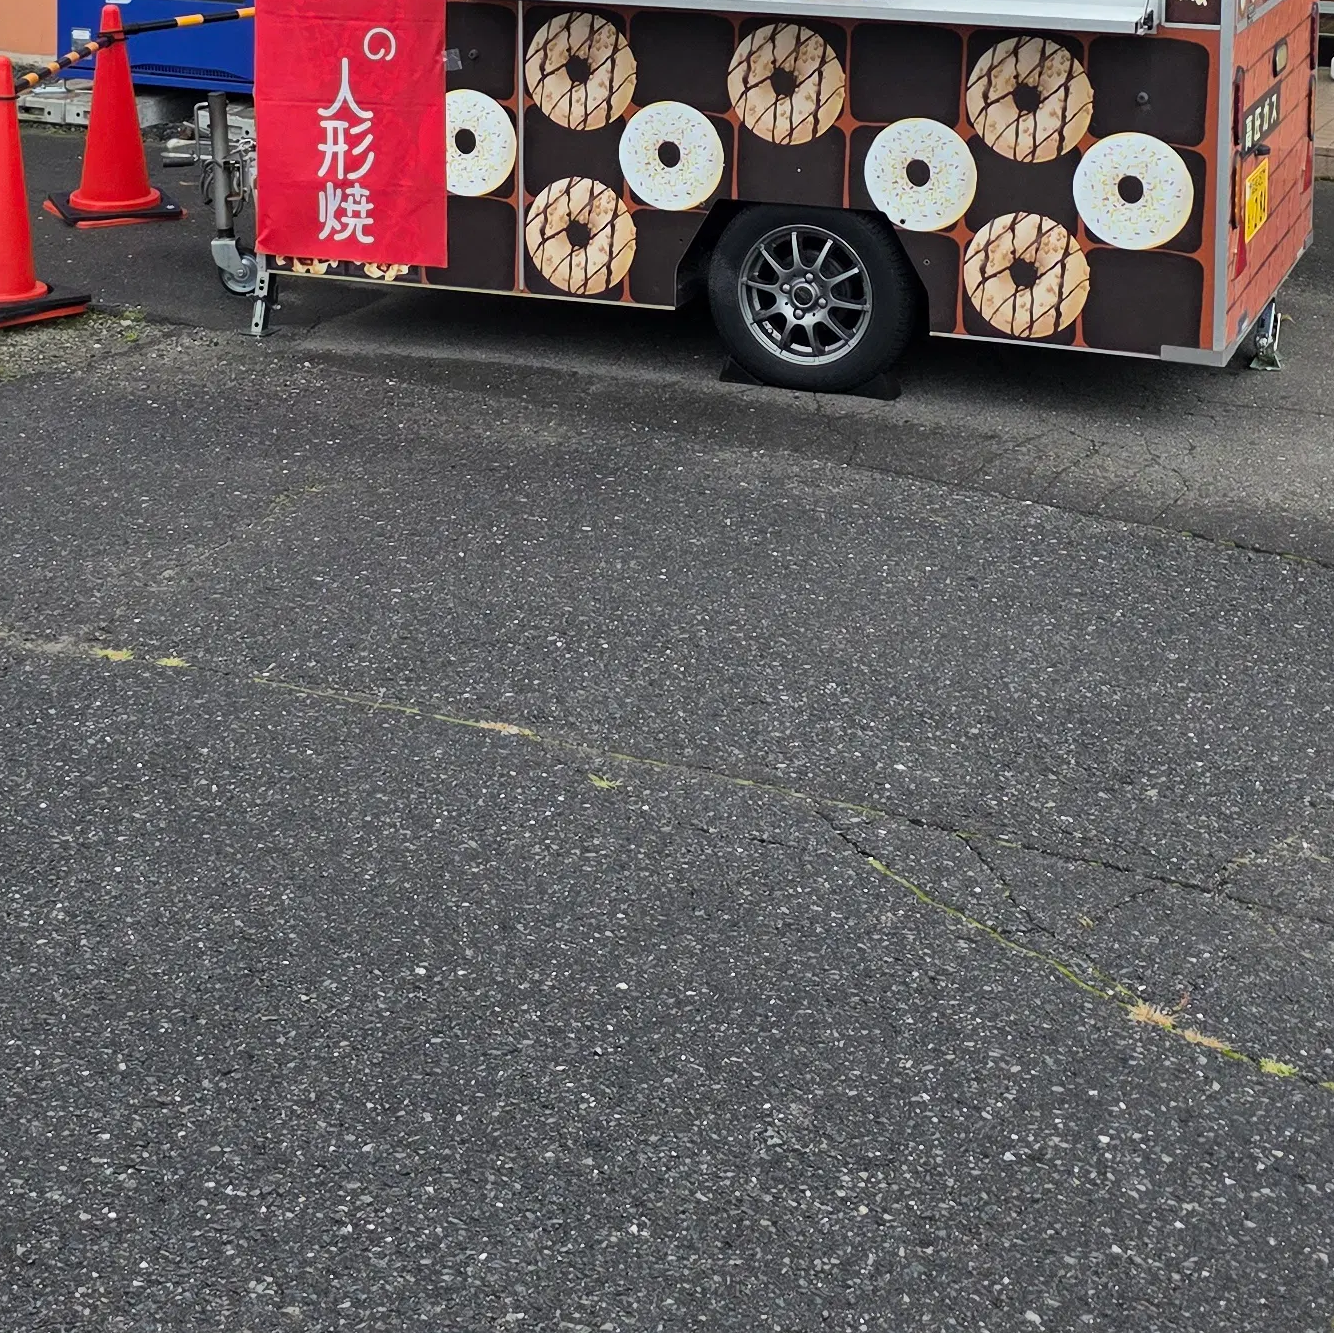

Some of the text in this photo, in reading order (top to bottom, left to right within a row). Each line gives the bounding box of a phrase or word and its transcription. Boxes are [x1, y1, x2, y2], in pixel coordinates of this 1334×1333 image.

[317, 57, 376, 245] 人形焼
[1244, 93, 1279, 153] 高圧ガス
